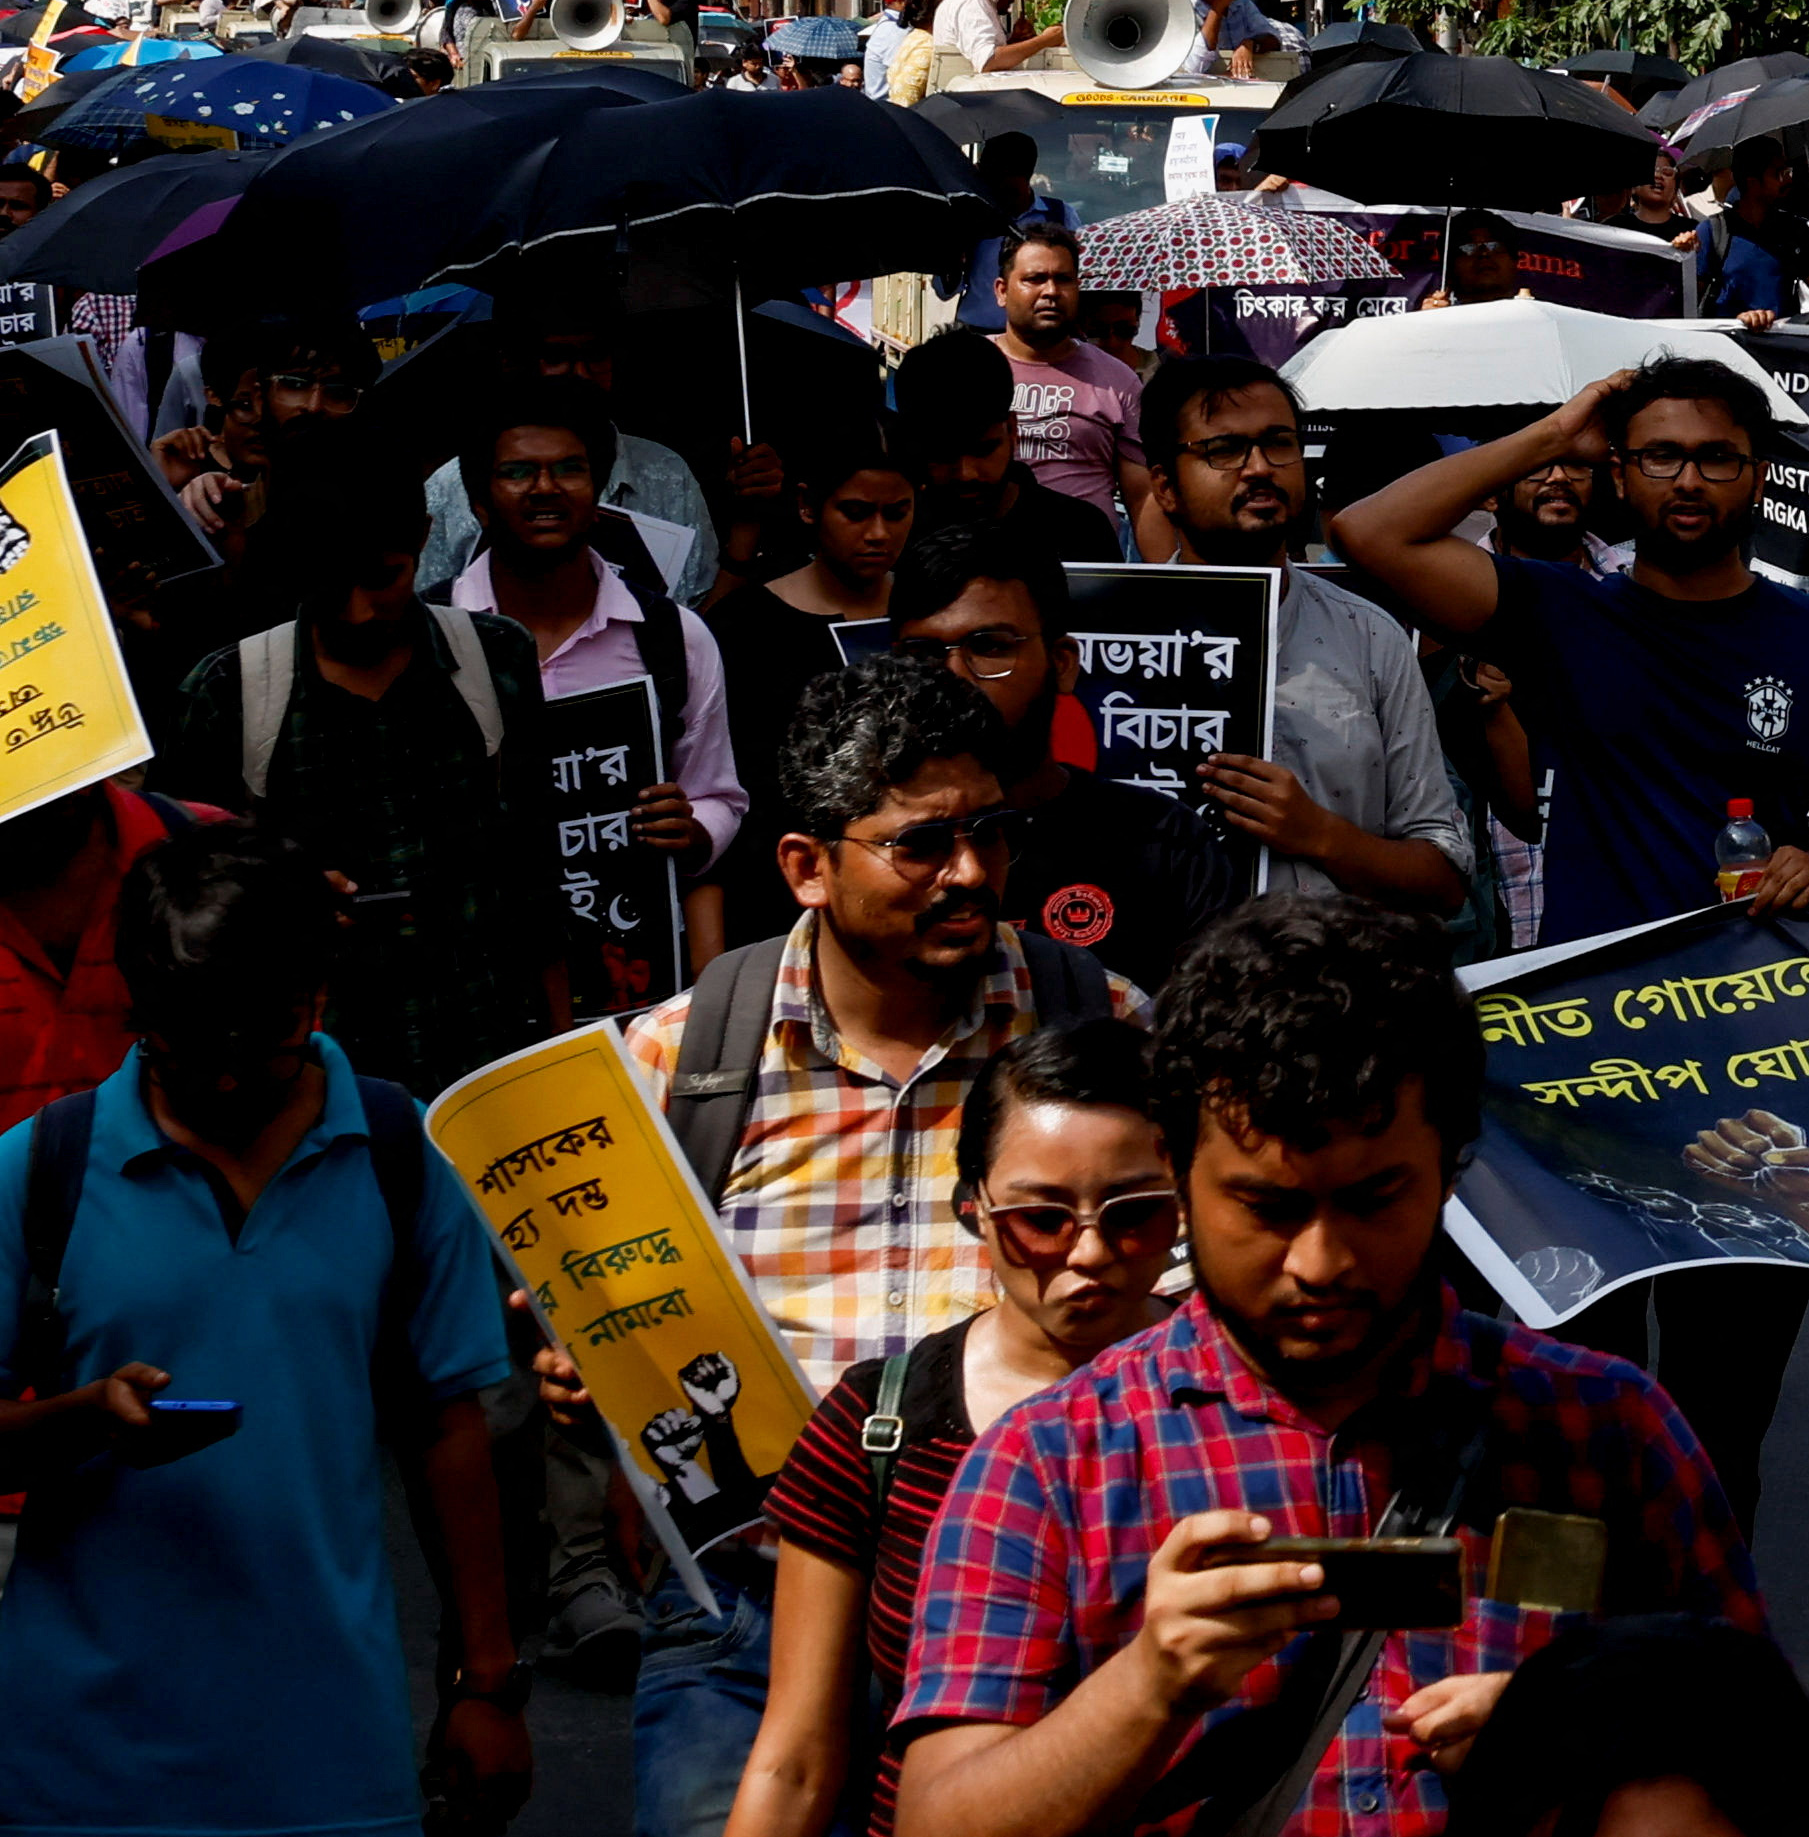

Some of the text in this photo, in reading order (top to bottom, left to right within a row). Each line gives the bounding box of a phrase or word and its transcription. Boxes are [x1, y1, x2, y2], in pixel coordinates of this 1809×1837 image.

[1076, 94, 1188, 103] GOODS CARRIAGE
[0, 310, 36, 335] চার
[1099, 690, 1232, 753] বিচার
[1746, 739, 1782, 755] HELLCAT
[557, 808, 634, 858] চার
[558, 867, 601, 923] ই
[1475, 992, 1593, 1047] নীত
[1521, 1058, 1709, 1107] সন্দীপ
[475, 1116, 615, 1195] শাসকের
[546, 1177, 609, 1218] দম্ভ
[561, 1227, 684, 1291] বিরুদ্ধে
[575, 1287, 695, 1348] নামবো
